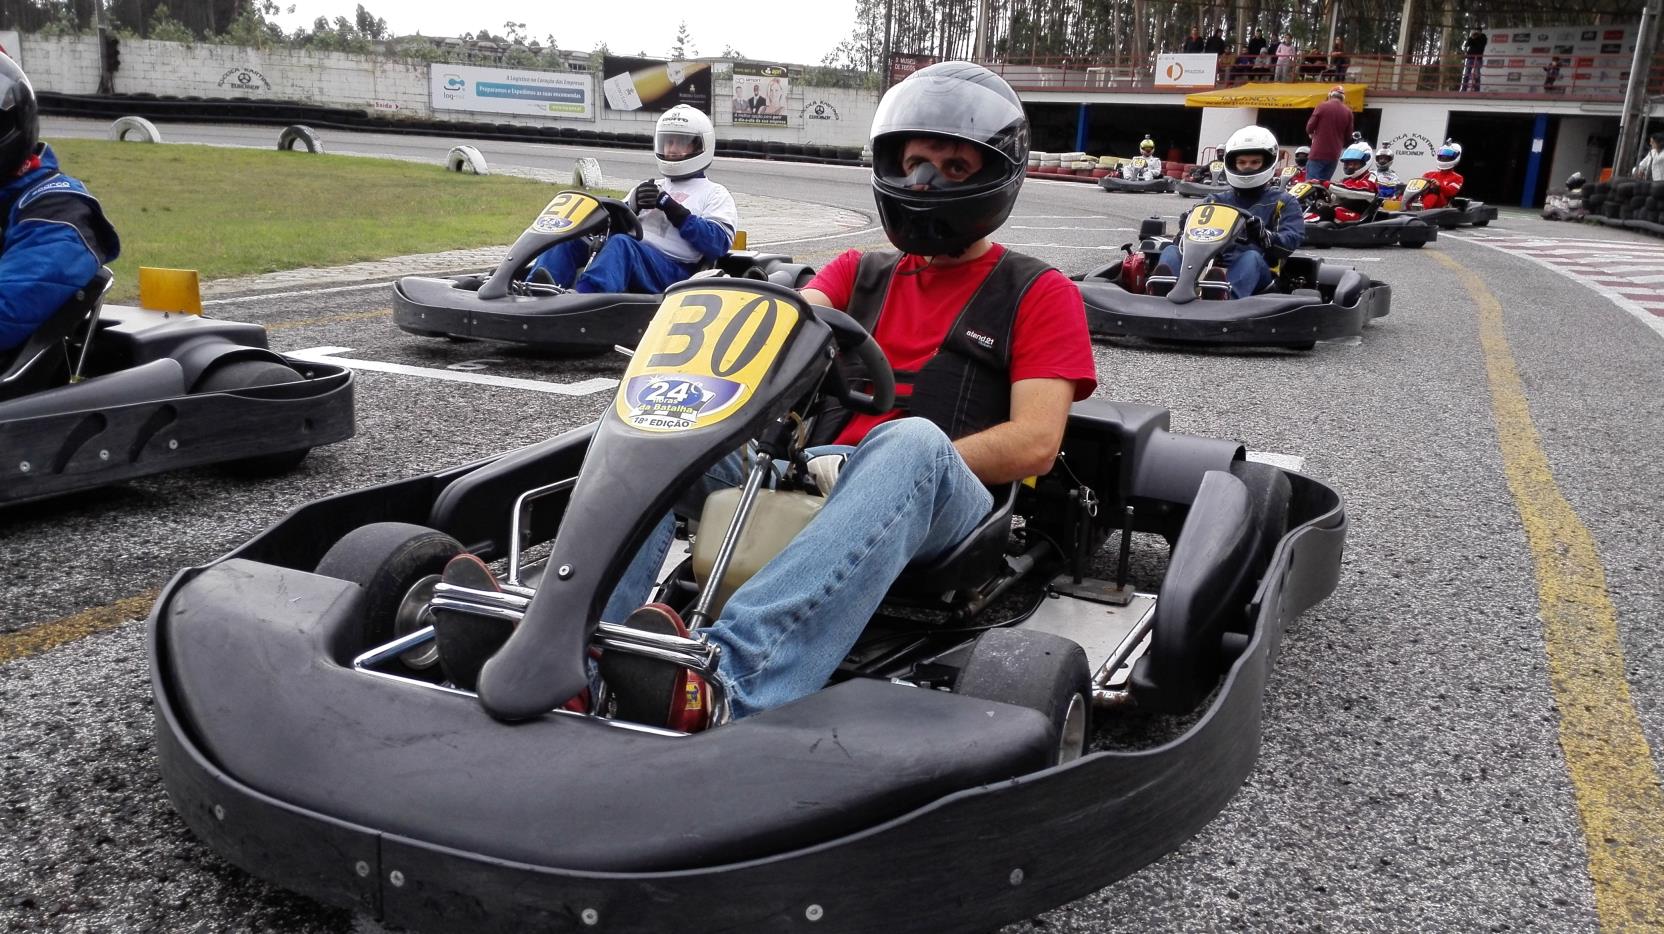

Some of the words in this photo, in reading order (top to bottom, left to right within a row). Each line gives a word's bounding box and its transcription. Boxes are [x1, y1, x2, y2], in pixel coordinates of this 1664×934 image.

[1412, 133, 1436, 156] KARTING
[543, 195, 585, 218] 21
[1198, 205, 1215, 225] 9
[646, 294, 777, 377] 30
[966, 330, 986, 342] stand
[985, 337, 994, 345] 21
[645, 382, 690, 402] 24
[654, 404, 693, 414] Batalha
[649, 419, 690, 428] EDIÇÃO
